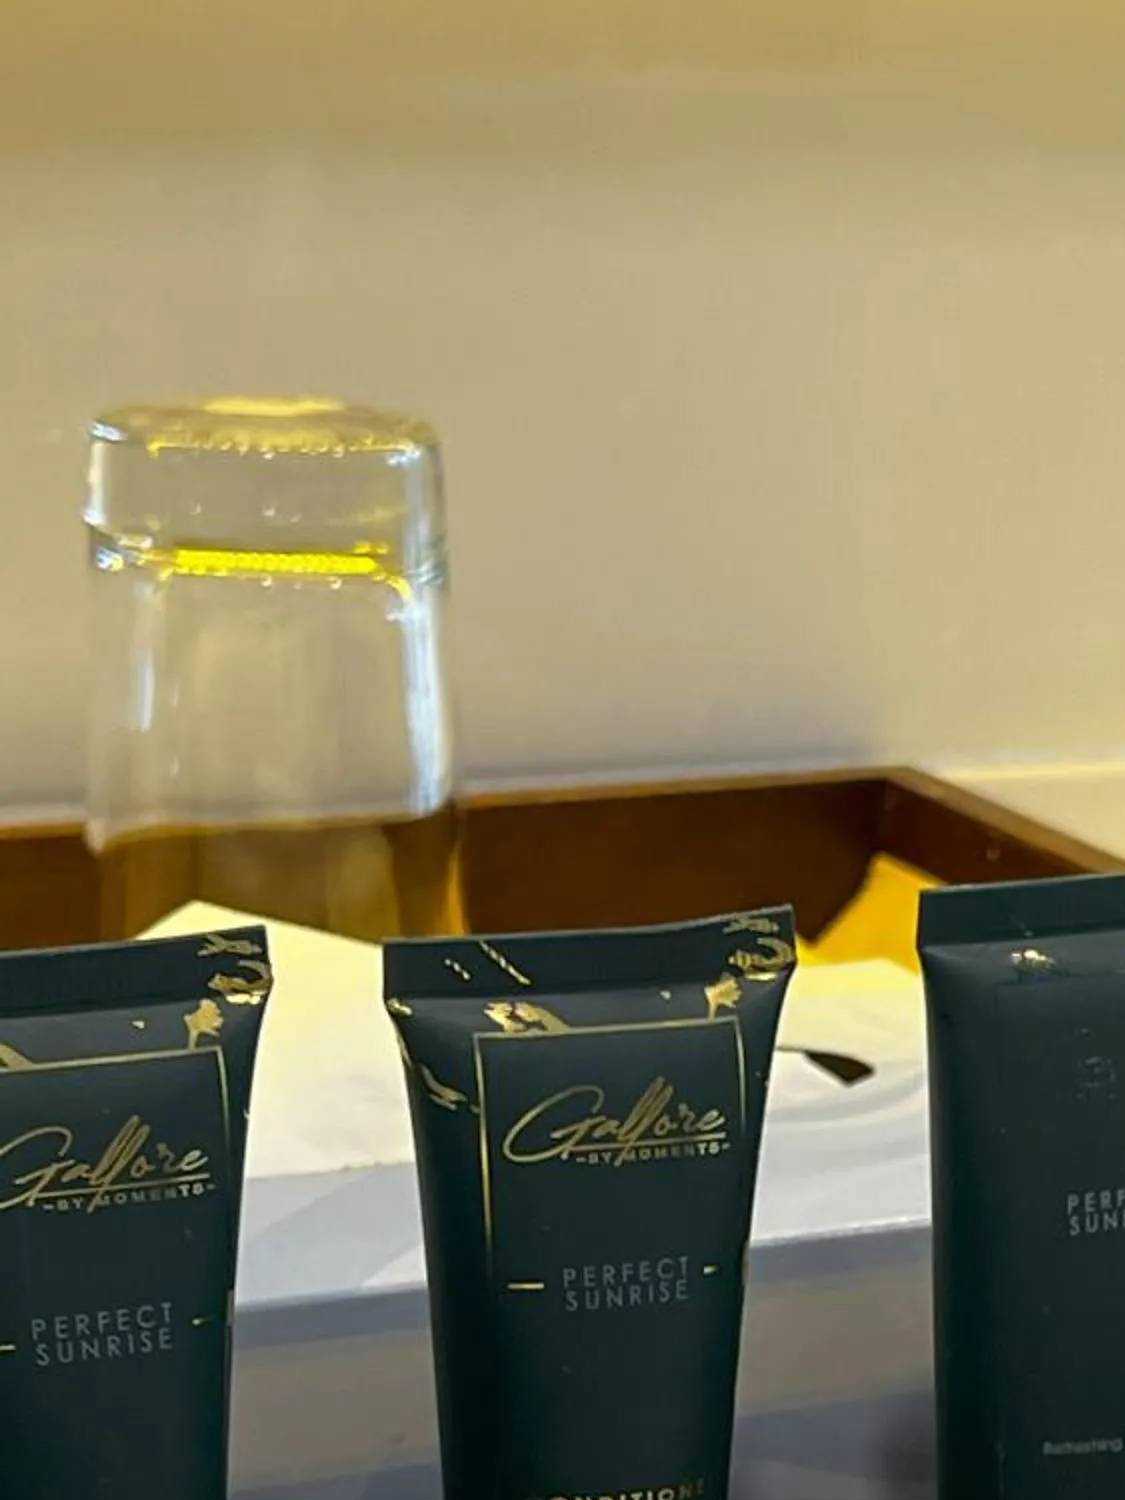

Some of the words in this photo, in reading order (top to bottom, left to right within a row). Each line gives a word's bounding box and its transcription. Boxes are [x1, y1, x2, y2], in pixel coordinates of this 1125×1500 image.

[563, 1256, 689, 1288] PERFECT
[565, 1279, 689, 1311] SUNRISE
[31, 1302, 172, 1341] PERFECT
[36, 1328, 172, 1366] SUNRISE
